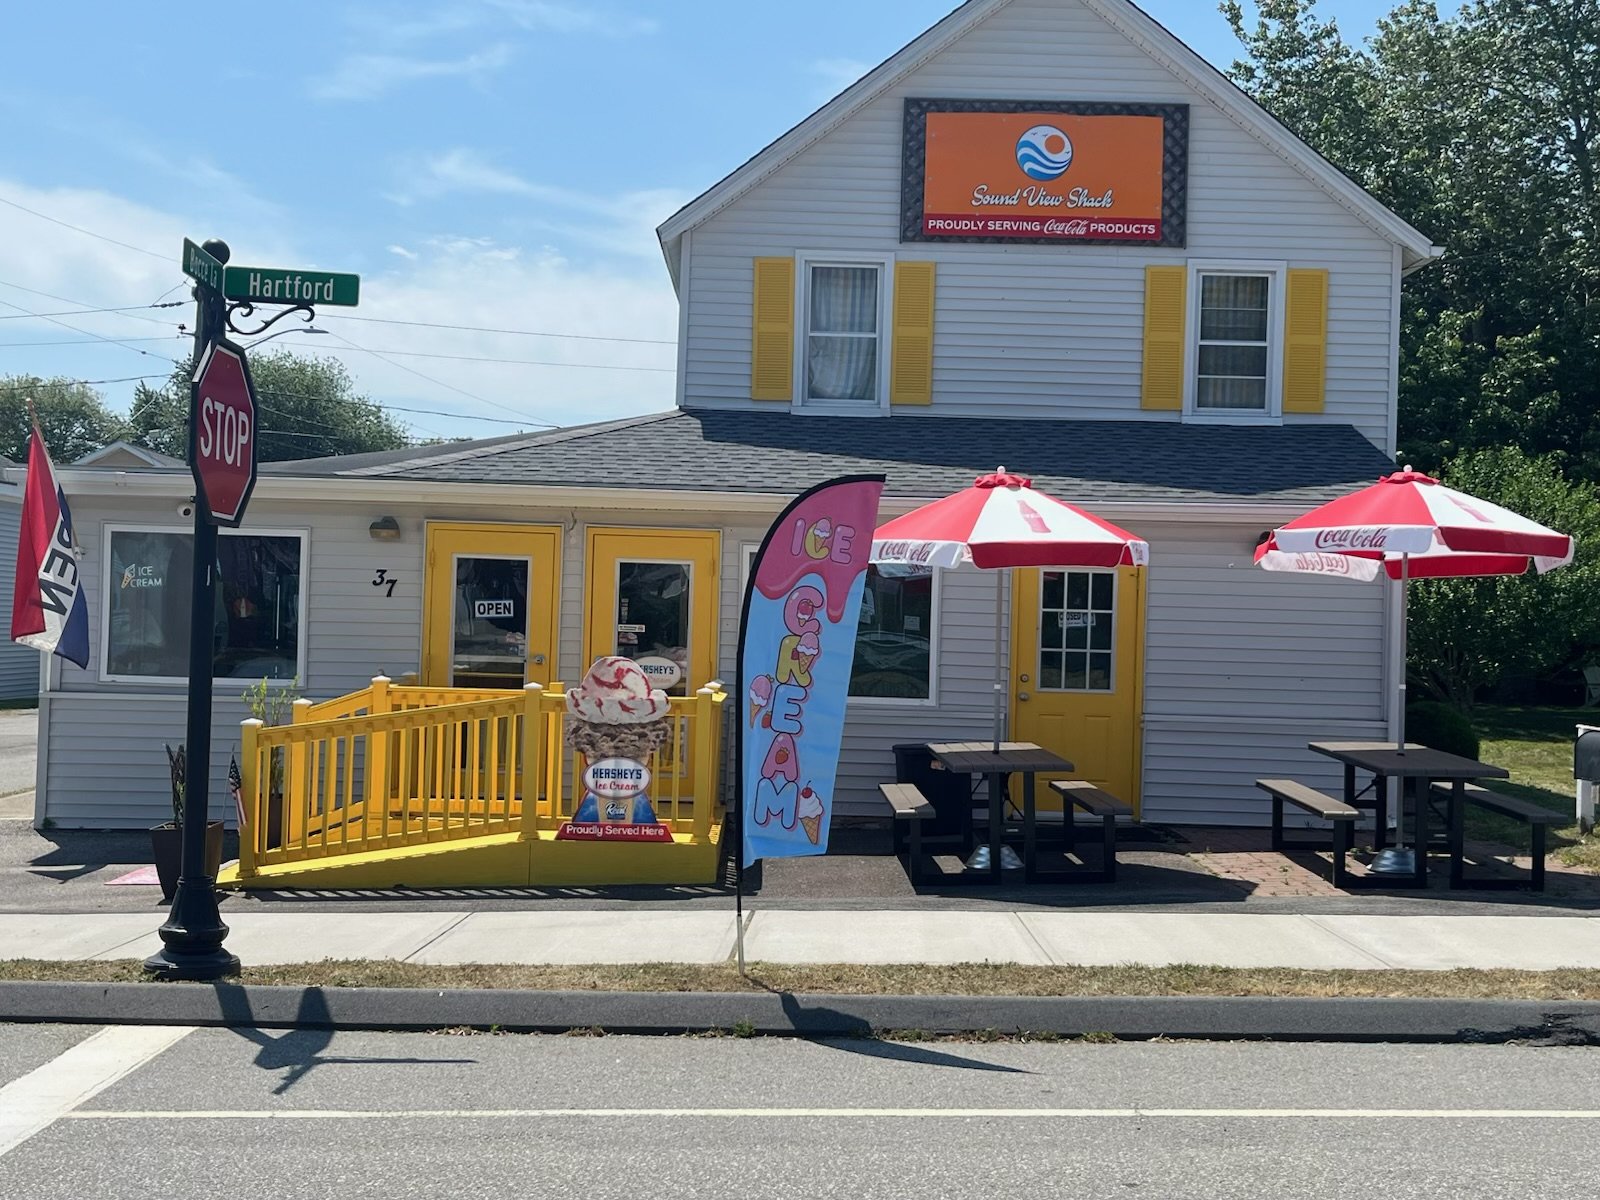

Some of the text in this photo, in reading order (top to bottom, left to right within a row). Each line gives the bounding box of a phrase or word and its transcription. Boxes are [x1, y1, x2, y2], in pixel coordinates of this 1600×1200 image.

[971, 185, 1114, 208] Sound View Shack
[928, 219, 985, 231] PROUDLY
[987, 220, 1040, 231] SERVING
[1090, 223, 1156, 235] PRODUCTS
[249, 273, 334, 300] Hartford
[200, 397, 250, 467] STOP
[790, 517, 856, 564] ICE
[38, 514, 79, 616] PEN
[138, 566, 153, 577] ICE
[130, 578, 162, 588] CREAM
[372, 569, 397, 598] 37
[477, 602, 512, 616] OPEN
[1059, 611, 1081, 620] COSED
[753, 585, 825, 831] CREAM
[592, 768, 642, 780] HERSHEY'S
[595, 780, 639, 791] Ice Cream
[566, 825, 665, 836] Proudly Served Here
